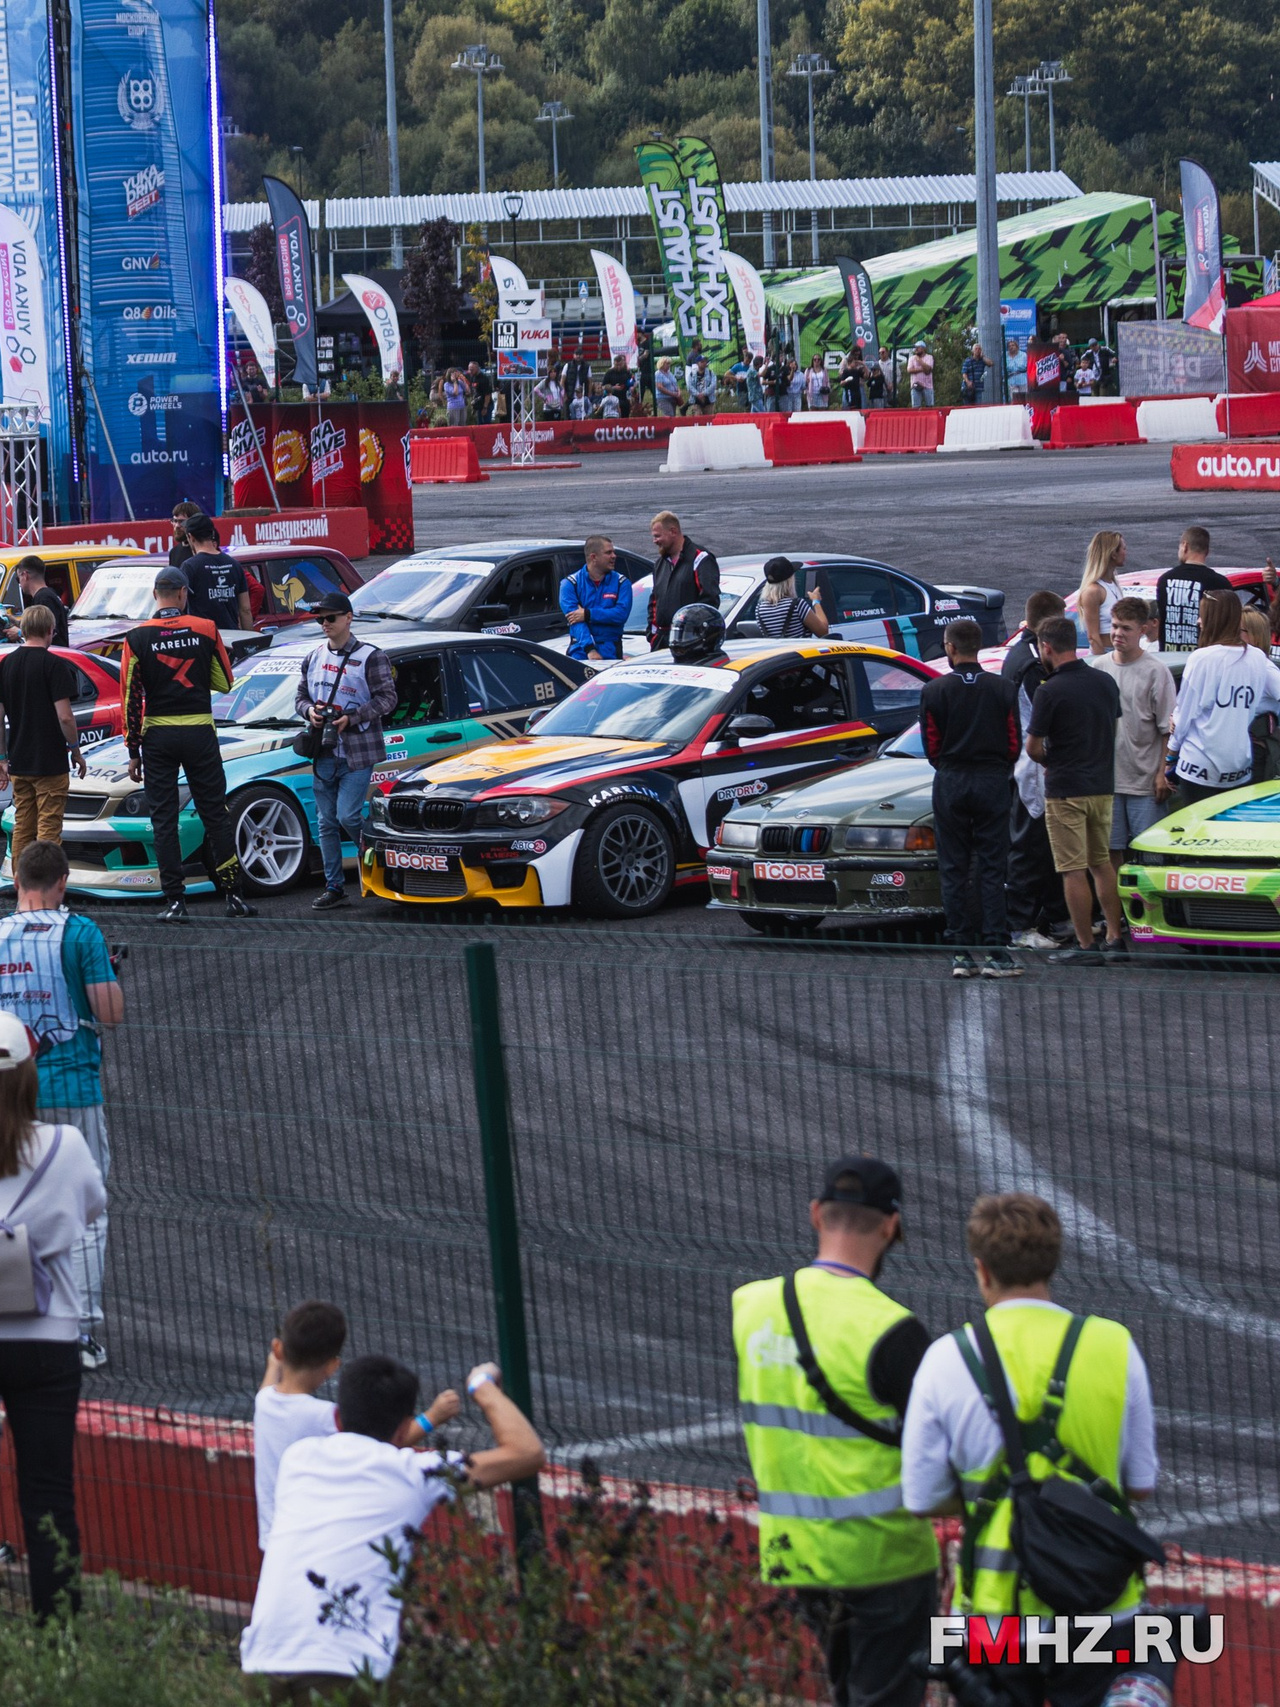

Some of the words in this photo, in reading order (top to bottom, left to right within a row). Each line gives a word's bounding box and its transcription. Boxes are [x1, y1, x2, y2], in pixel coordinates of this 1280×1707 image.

[127, 25, 148, 36] СПОРТ
[12, 90, 40, 193] СПОРТ
[123, 164, 158, 190] YUKA
[126, 171, 165, 202] DRIVE
[122, 257, 150, 270] GNV
[649, 183, 697, 337] EXHAUST
[688, 177, 732, 341] EXHAUST
[123, 306, 140, 319] Q8
[153, 304, 177, 318] Oils
[497, 322, 515, 334] ГО
[520, 329, 549, 340] YUKA
[497, 335, 516, 348] НКА
[126, 352, 177, 364] XENUM
[150, 396, 178, 404] POWER
[150, 402, 182, 410] WHEELS
[594, 425, 655, 442] auto.ru
[311, 430, 346, 462] RIVE
[131, 449, 188, 464] auto.ru
[1197, 454, 1280, 478] auto.ru
[255, 514, 329, 542] МОСКОВСКИЙ
[1167, 587, 1200, 608] YUKA
[1166, 610, 1181, 624] ADV
[1182, 611, 1199, 625] PRO
[482, 626, 512, 636] DRYDRY
[1165, 629, 1199, 644] RACING
[151, 637, 200, 652] KARELIN
[830, 645, 867, 654] KARELIN
[322, 663, 347, 675] MEDA
[80, 730, 104, 744] ADV
[387, 751, 407, 761] REST
[370, 771, 400, 782] uto.ru
[1180, 760, 1210, 781] UFA
[587, 784, 660, 809] KARELIN
[718, 784, 755, 801] DRYDRY
[708, 865, 732, 877] РАЙВ
